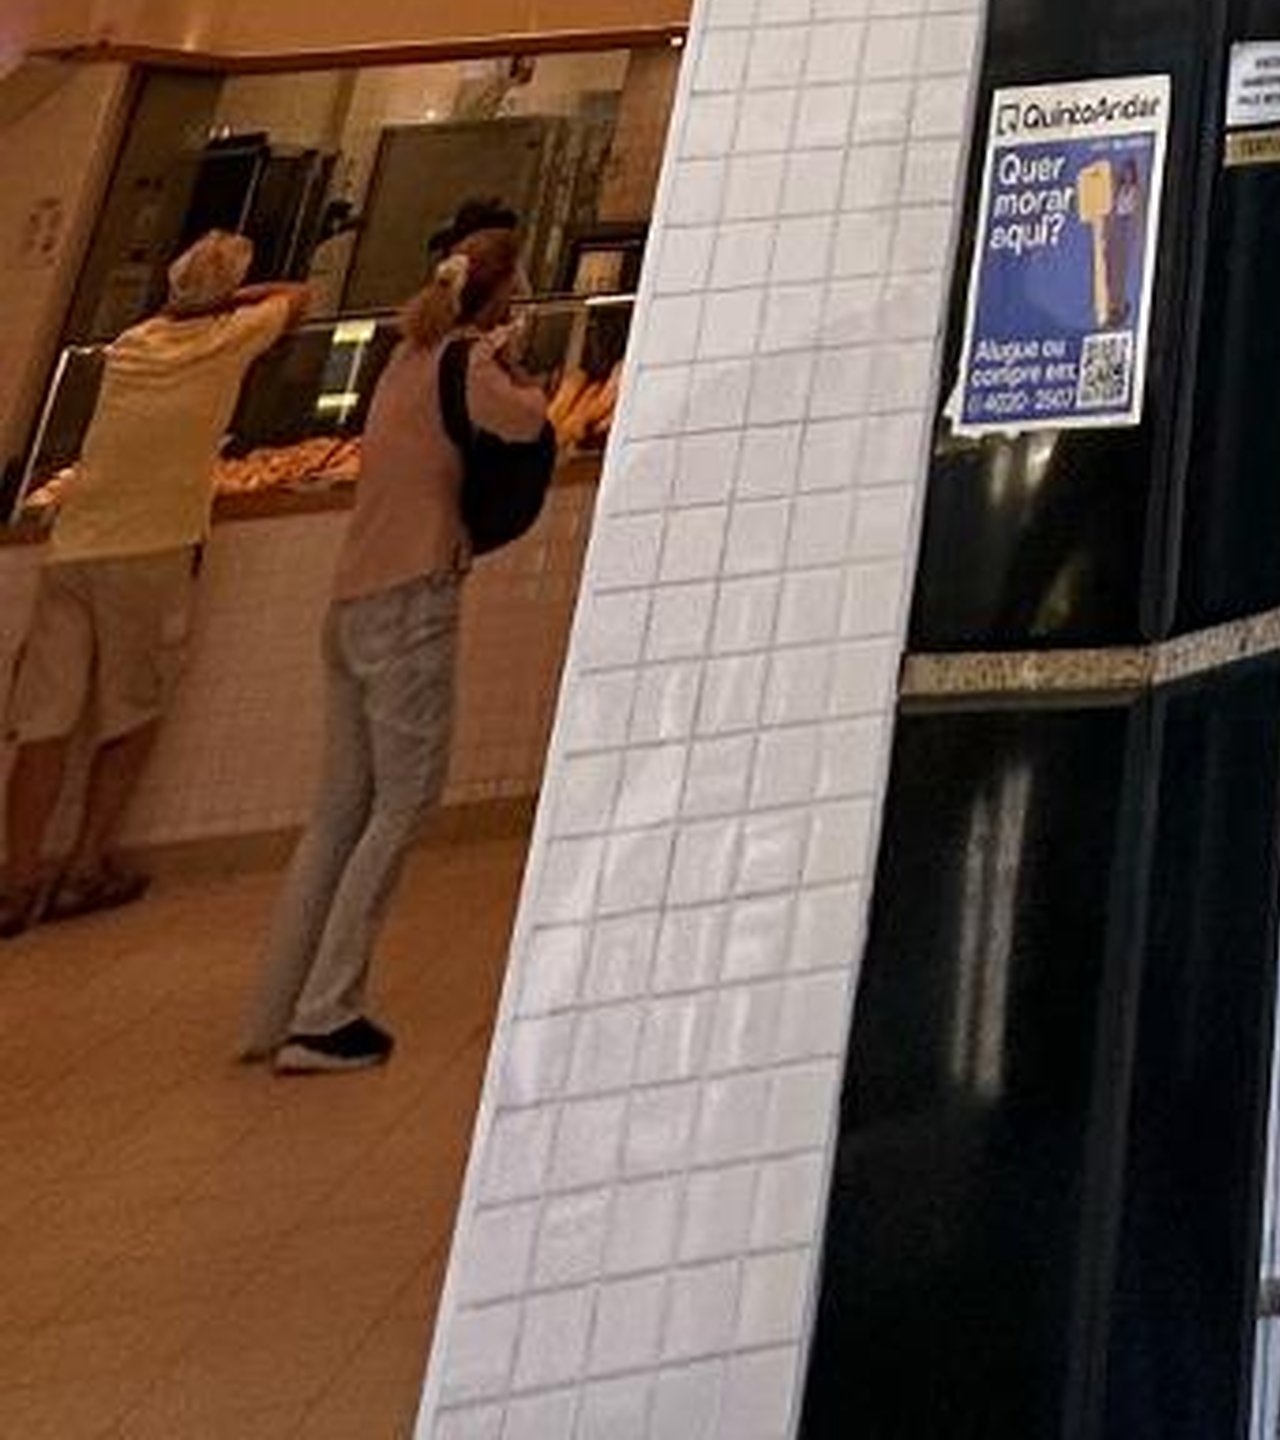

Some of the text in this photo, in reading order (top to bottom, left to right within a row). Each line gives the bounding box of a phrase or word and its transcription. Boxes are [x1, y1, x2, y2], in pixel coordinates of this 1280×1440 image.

[1022, 95, 1161, 129] QuintoAndar
[998, 154, 1066, 186] Quer
[993, 186, 1076, 218] morar
[990, 212, 1065, 256] aqui?
